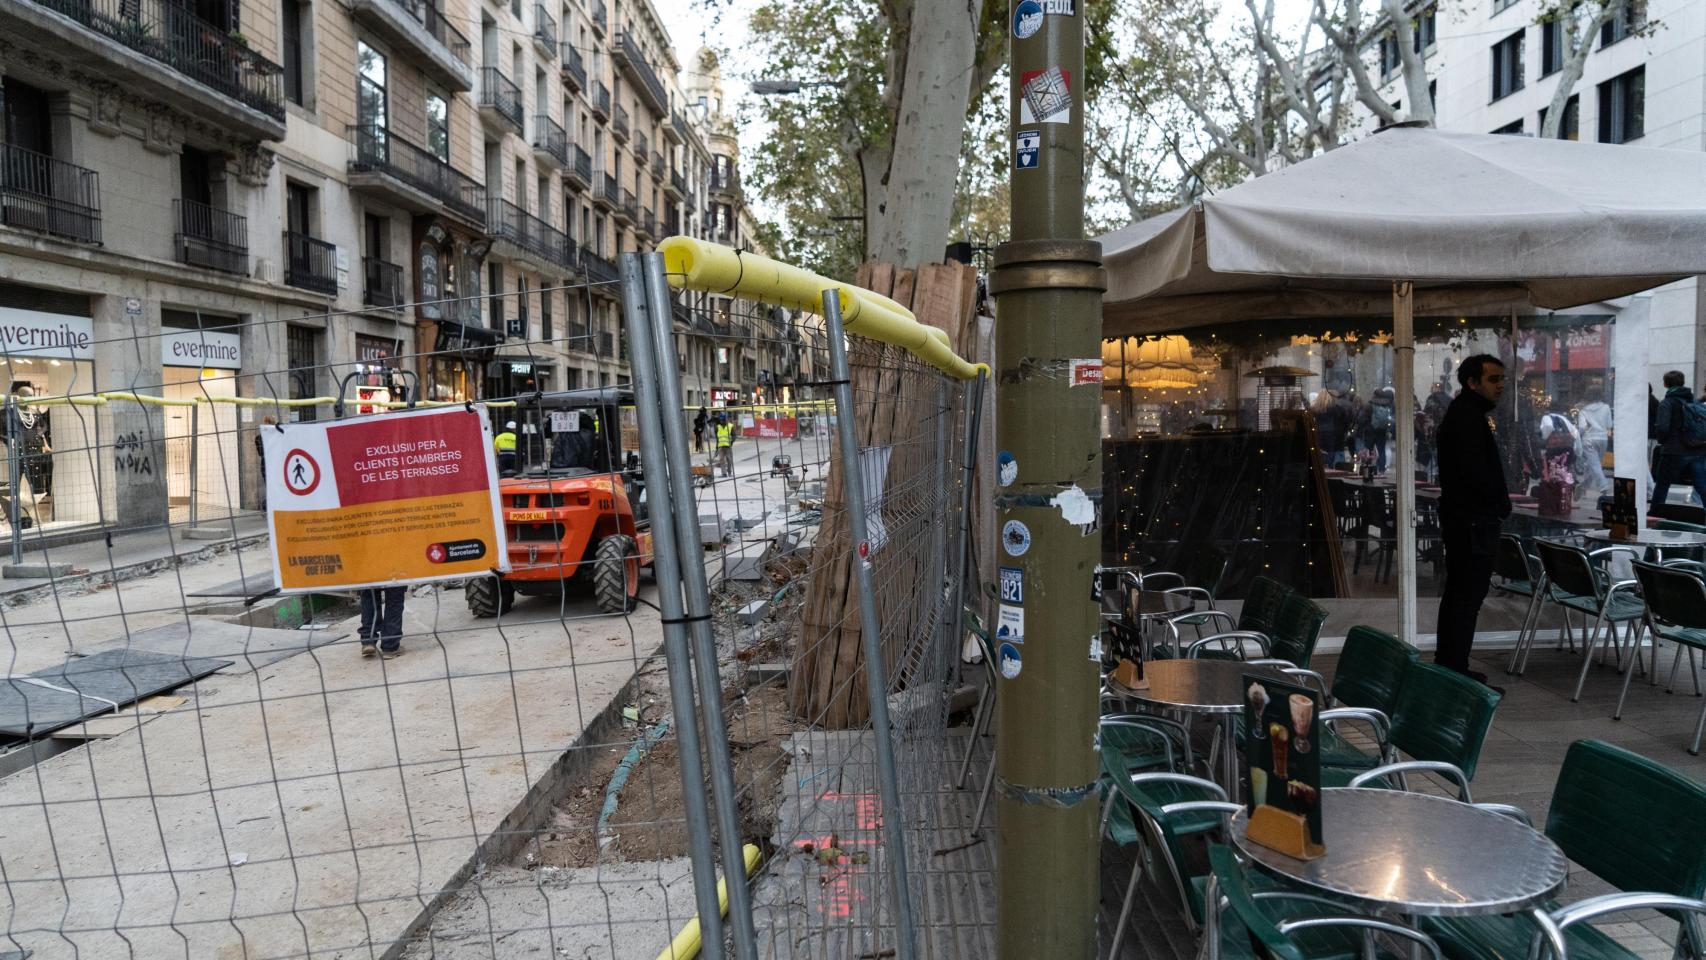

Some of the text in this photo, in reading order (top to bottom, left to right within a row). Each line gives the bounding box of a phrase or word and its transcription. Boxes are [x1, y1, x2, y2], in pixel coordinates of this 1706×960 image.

[0, 324, 89, 350] vermine
[173, 340, 238, 360] evermine
[366, 439, 447, 456] EXCLUSIU PER A
[354, 450, 462, 471] CLIENTS I CAMBRERS
[361, 463, 459, 484] DE LES TERRASSES
[449, 549, 480, 557] Barcelona
[1000, 580, 1022, 602] 1921
